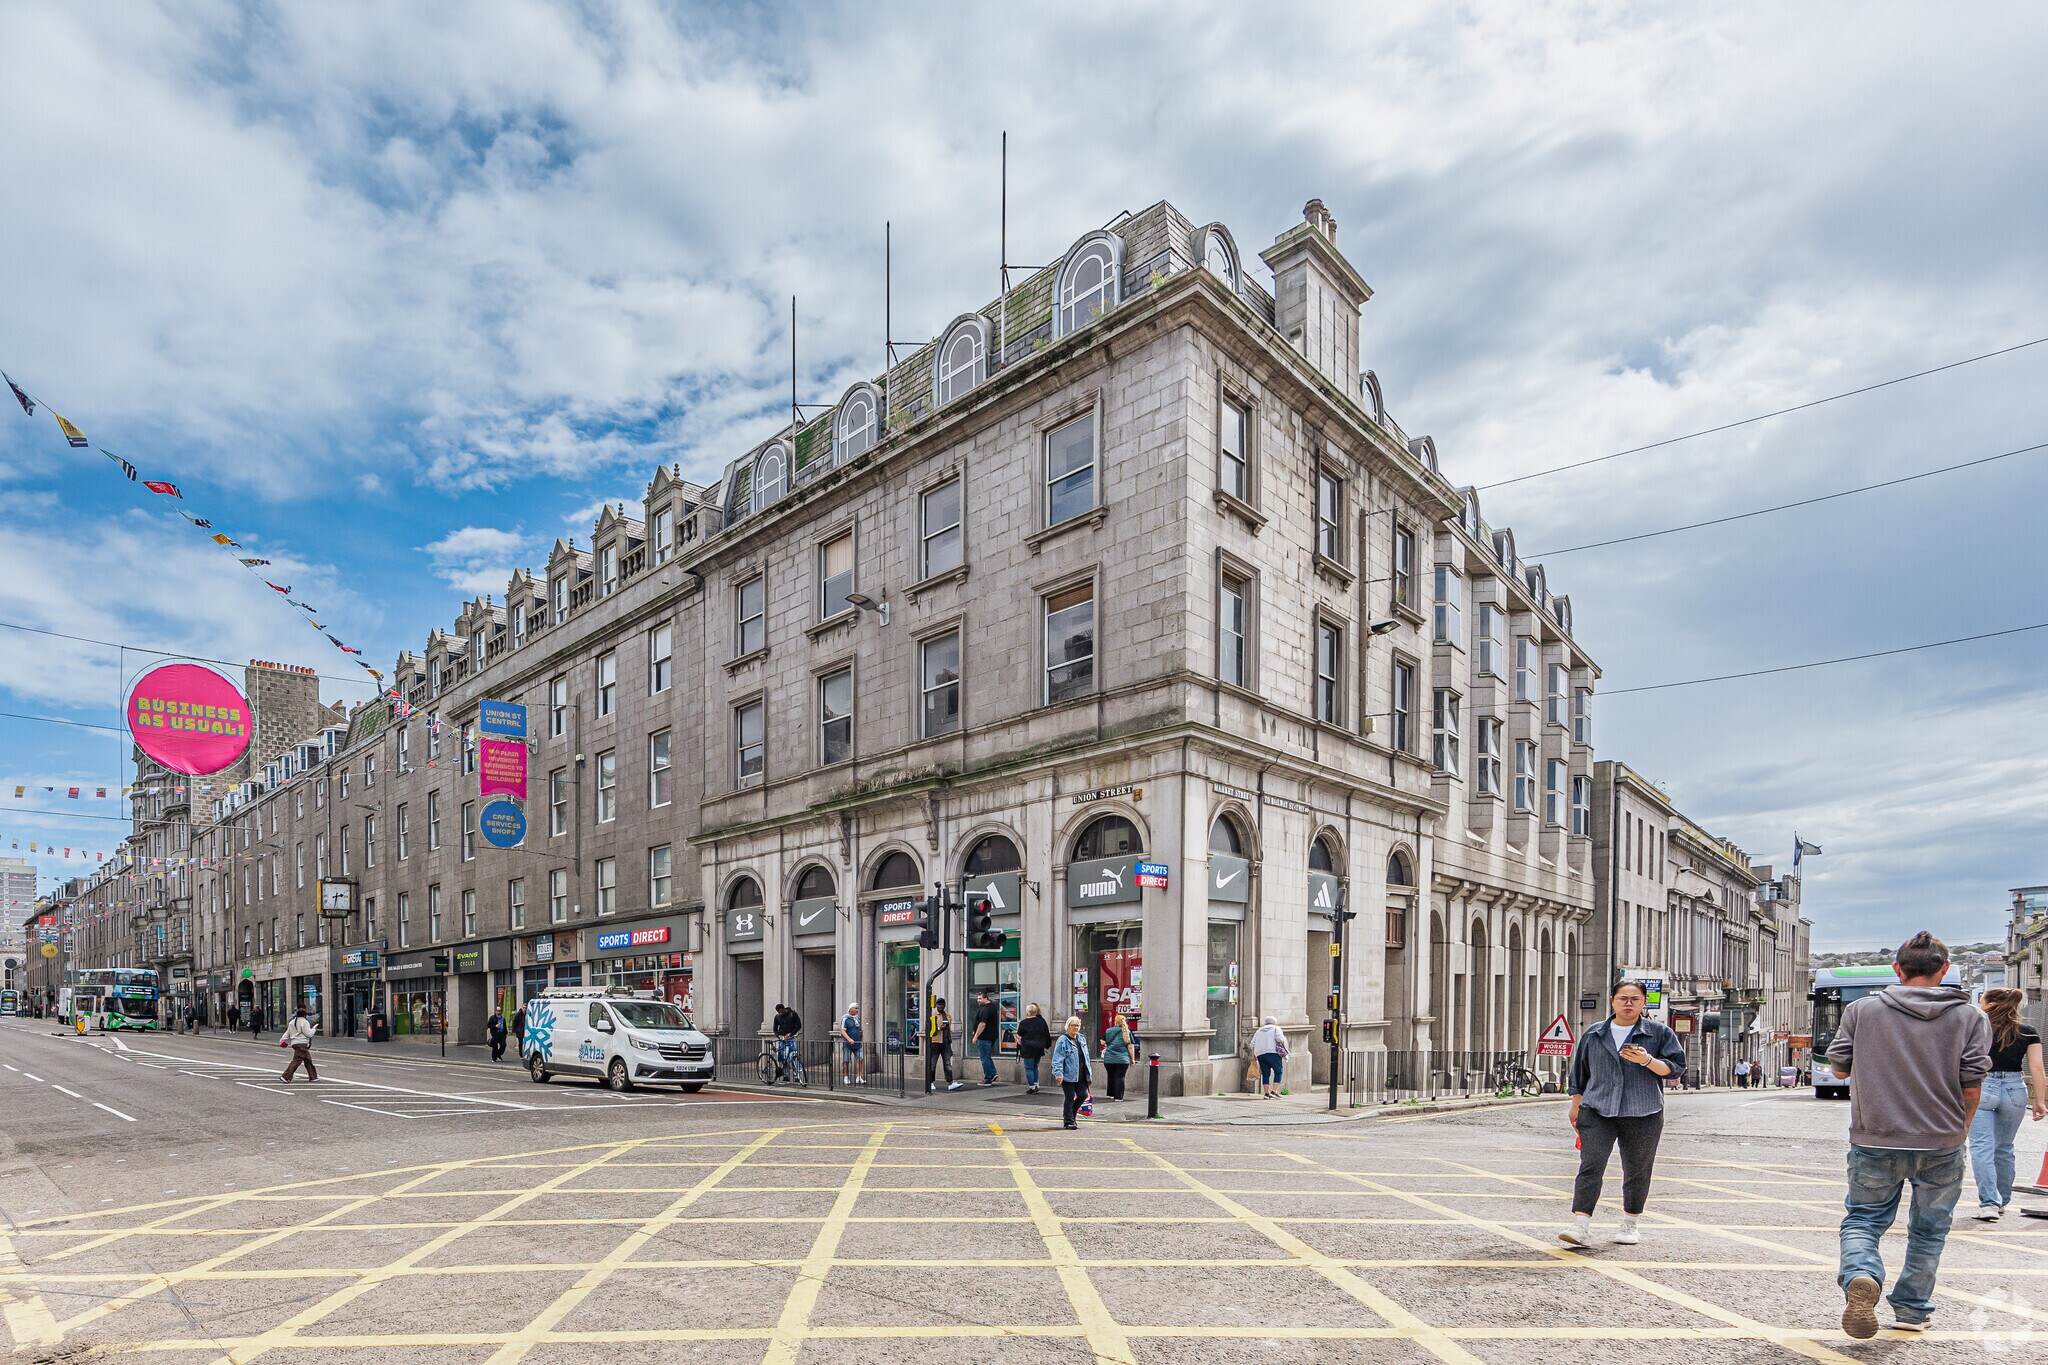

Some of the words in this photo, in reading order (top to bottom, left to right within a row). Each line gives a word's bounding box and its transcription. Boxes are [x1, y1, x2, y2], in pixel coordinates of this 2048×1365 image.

[136, 697, 240, 721] BUSINESS
[485, 709, 510, 718] UNION
[511, 712, 521, 720] ST
[137, 713, 164, 727] AS
[169, 716, 244, 737] USUAL!
[485, 717, 521, 727] CENTRAL
[484, 762, 515, 770] ENTRANCE
[486, 775, 515, 783] BUILDING
[1073, 791, 1097, 804] UNION
[1100, 785, 1132, 798] STREET
[1214, 783, 1234, 795] MARKET
[492, 813, 515, 822] CAFES
[486, 820, 521, 829] SERVICES
[492, 827, 516, 836] SHOPS
[1141, 864, 1168, 875] SPORTS
[1141, 876, 1168, 887] DIRECT
[1079, 880, 1116, 899] PUMA
[883, 901, 912, 912] SPORTS
[883, 911, 912, 922] DIRECT
[599, 933, 629, 947] SPORTS
[632, 928, 665, 944] DIRECT
[456, 951, 479, 960] EVANS
[583, 1045, 605, 1060] Atlas
